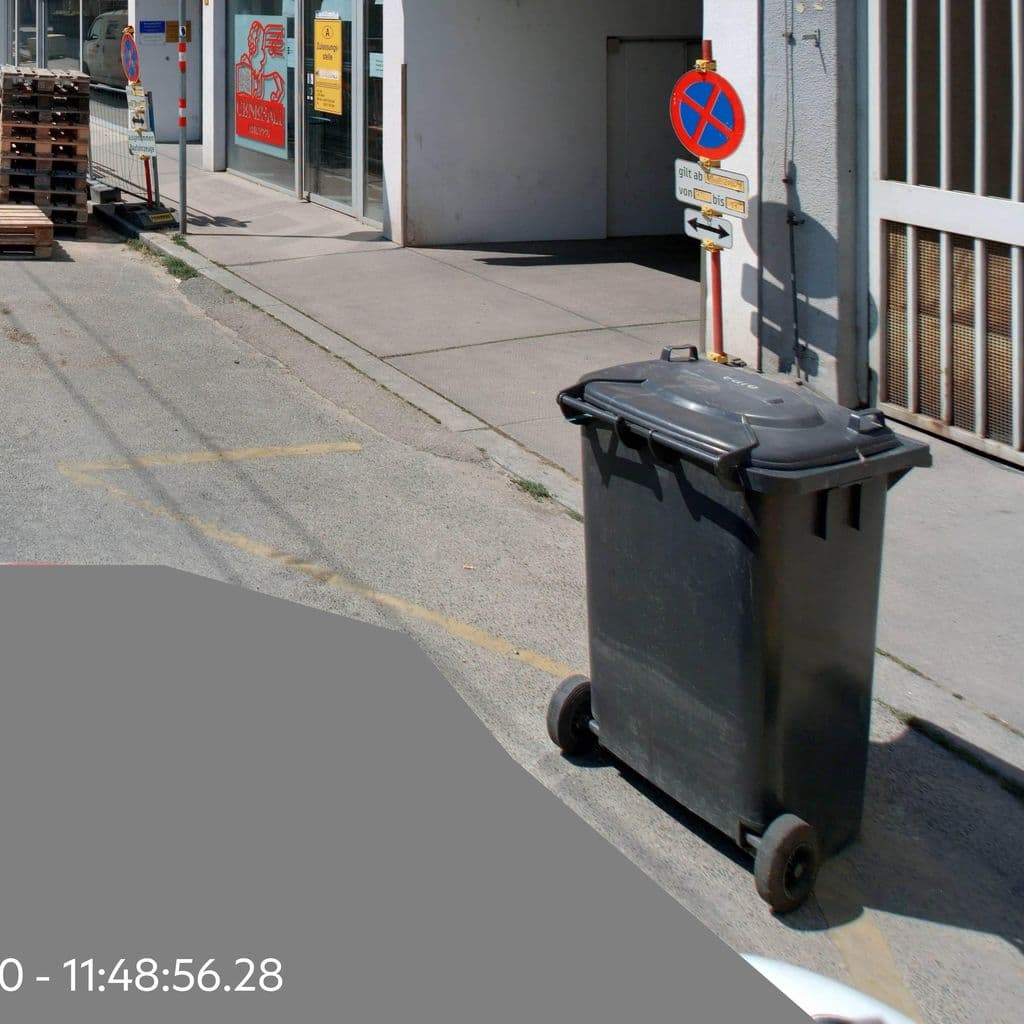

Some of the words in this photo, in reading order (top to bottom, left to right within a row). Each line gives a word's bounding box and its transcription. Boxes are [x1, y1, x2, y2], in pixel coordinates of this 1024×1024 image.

[678, 166, 692, 179] gilt
[693, 171, 703, 182] ab
[678, 186, 693, 198] von
[712, 193, 725, 207] bis
